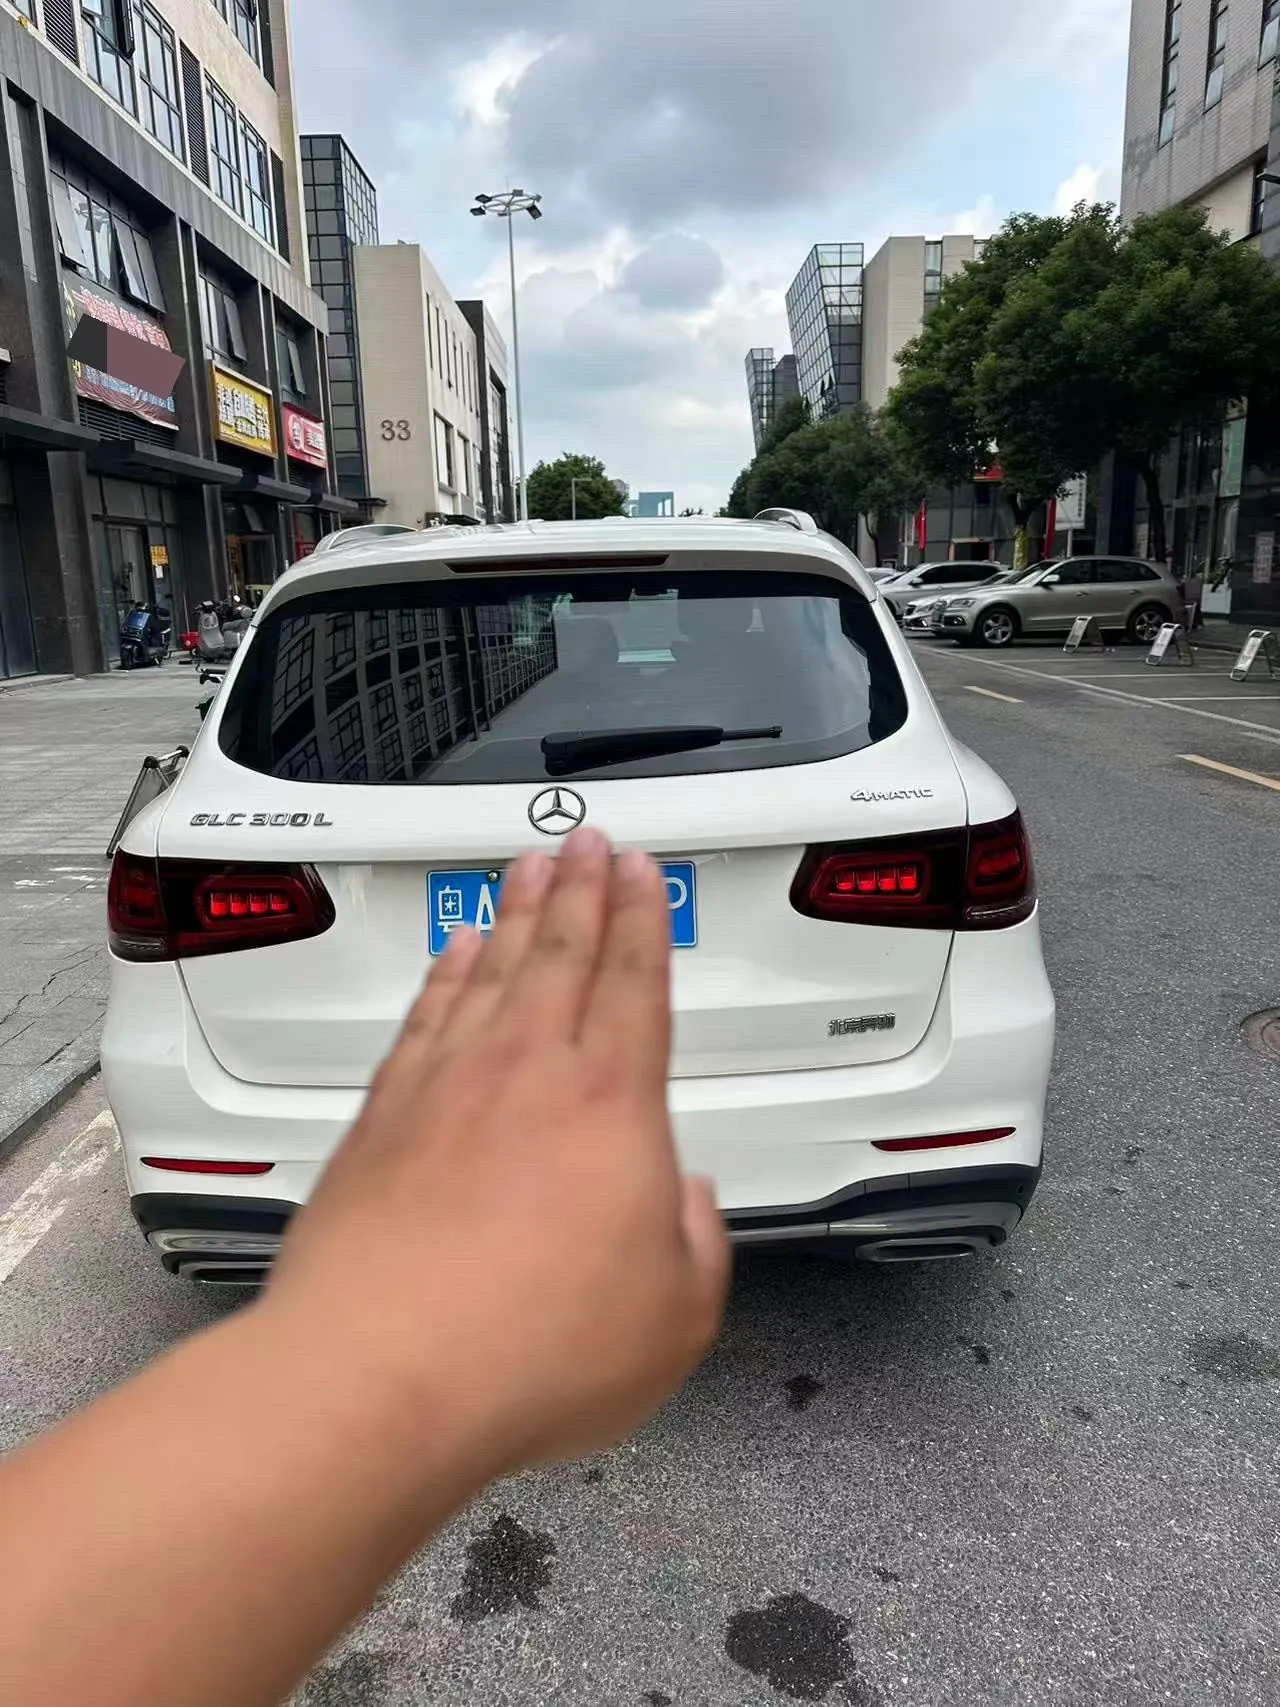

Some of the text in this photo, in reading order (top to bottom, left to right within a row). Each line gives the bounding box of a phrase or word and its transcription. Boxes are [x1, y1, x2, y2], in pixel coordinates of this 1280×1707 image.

[381, 419, 411, 441] 33
[850, 787, 934, 802] 4MATIC
[189, 812, 334, 827] GLC 300 L
